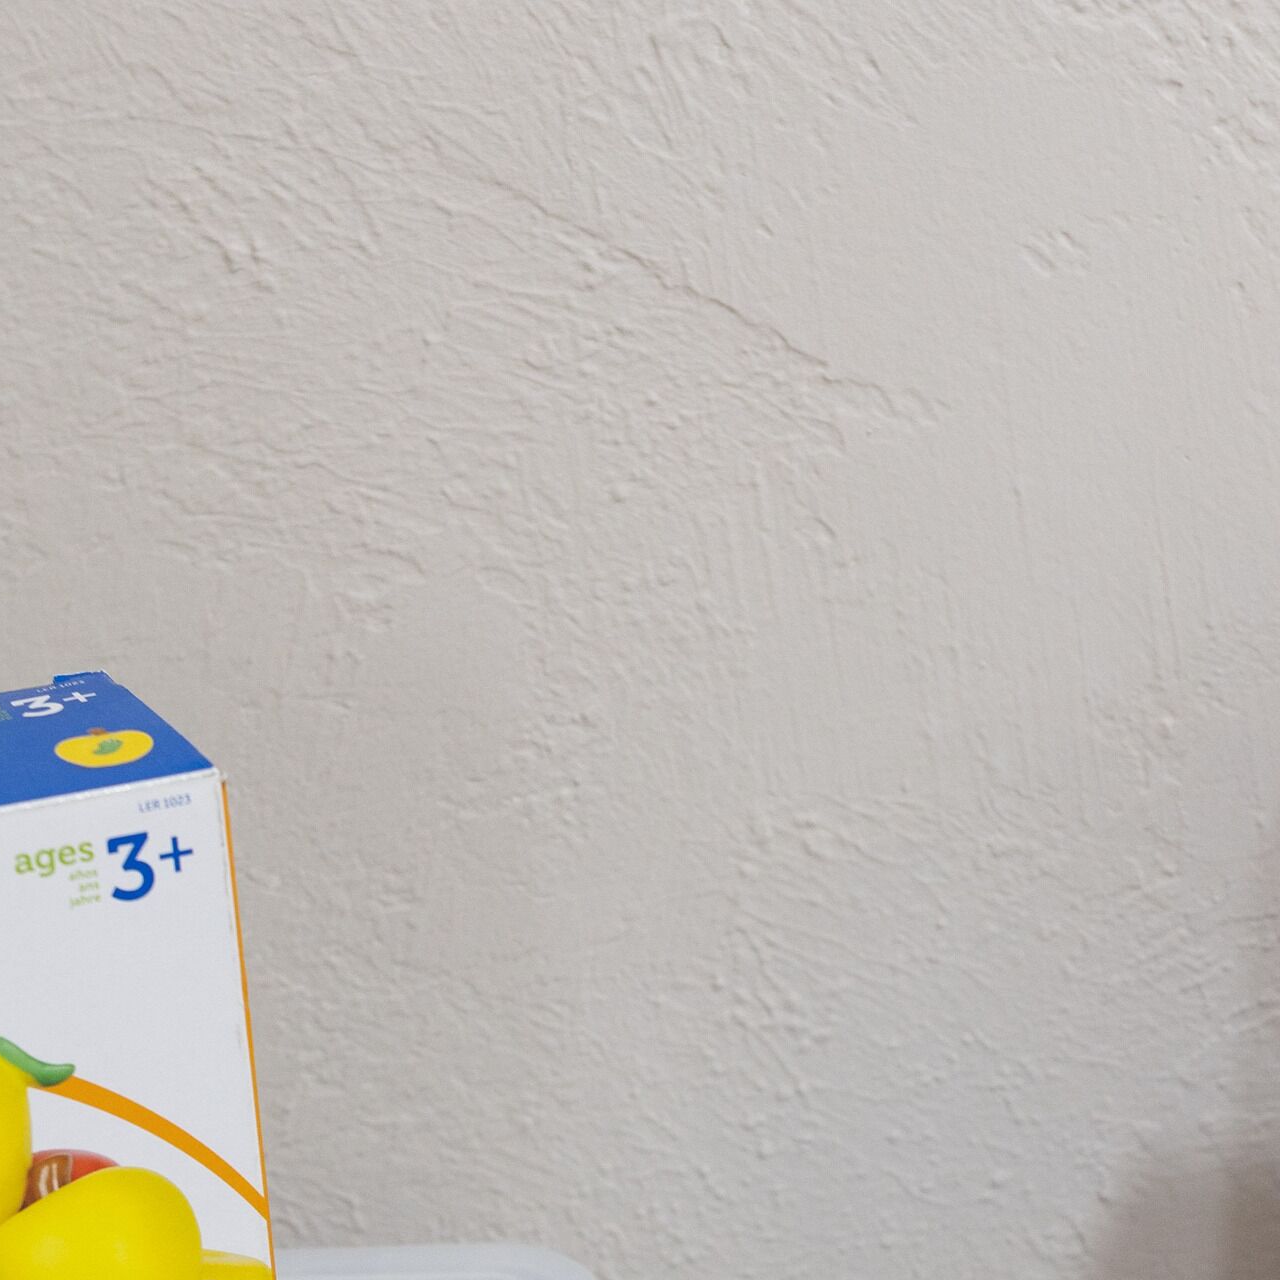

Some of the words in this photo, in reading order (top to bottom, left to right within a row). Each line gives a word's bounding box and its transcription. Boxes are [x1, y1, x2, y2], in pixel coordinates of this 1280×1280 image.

[10, 691, 97, 718] 3+
[15, 841, 94, 878] ages
[107, 831, 193, 901] 3+
